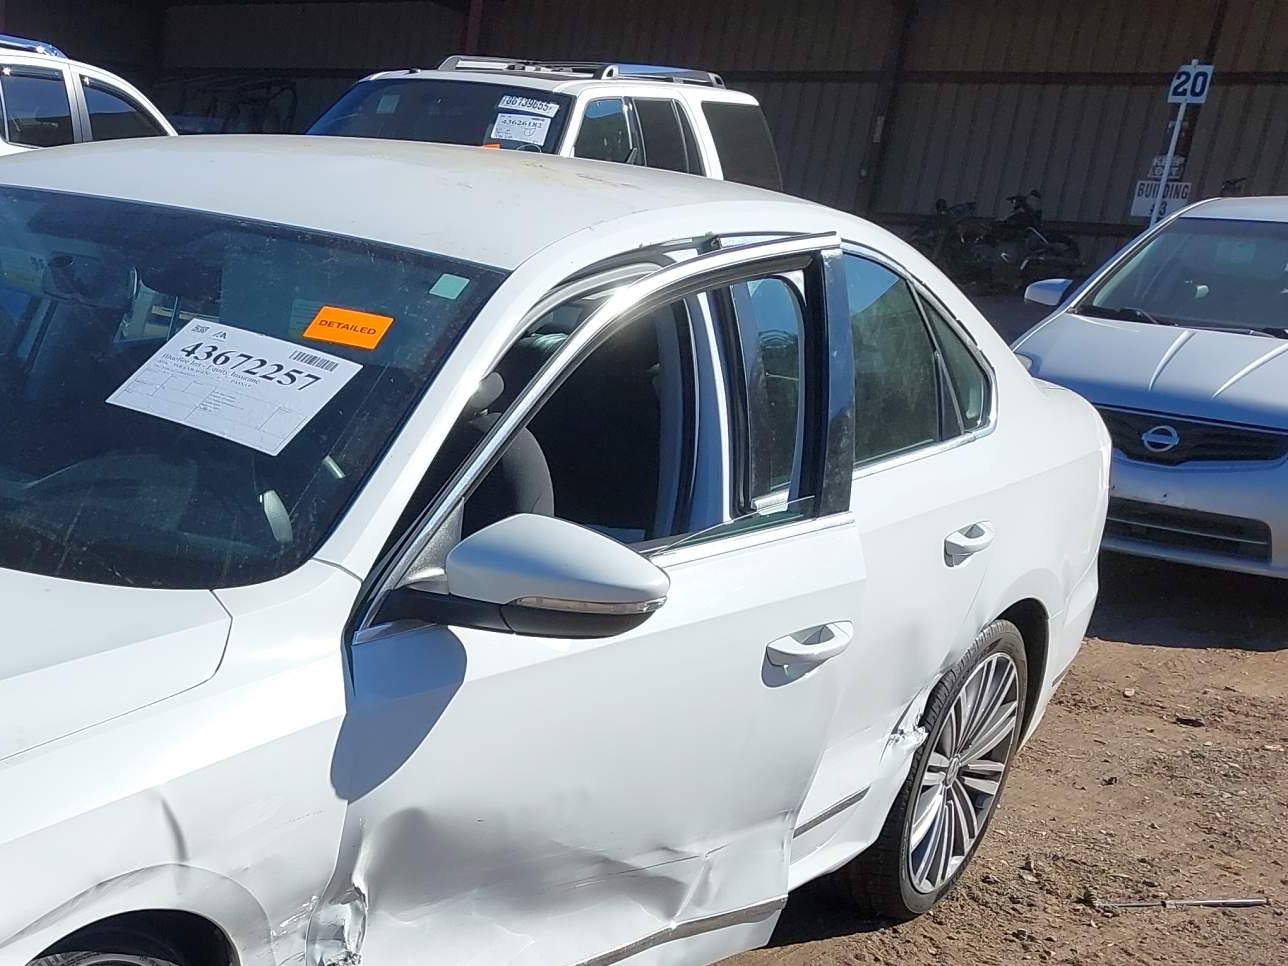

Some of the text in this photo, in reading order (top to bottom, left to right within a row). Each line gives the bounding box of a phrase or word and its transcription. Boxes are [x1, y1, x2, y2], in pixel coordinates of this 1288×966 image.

[1172, 71, 1209, 97] 20
[318, 319, 376, 336] DETAILED
[180, 341, 323, 391] 43672257
